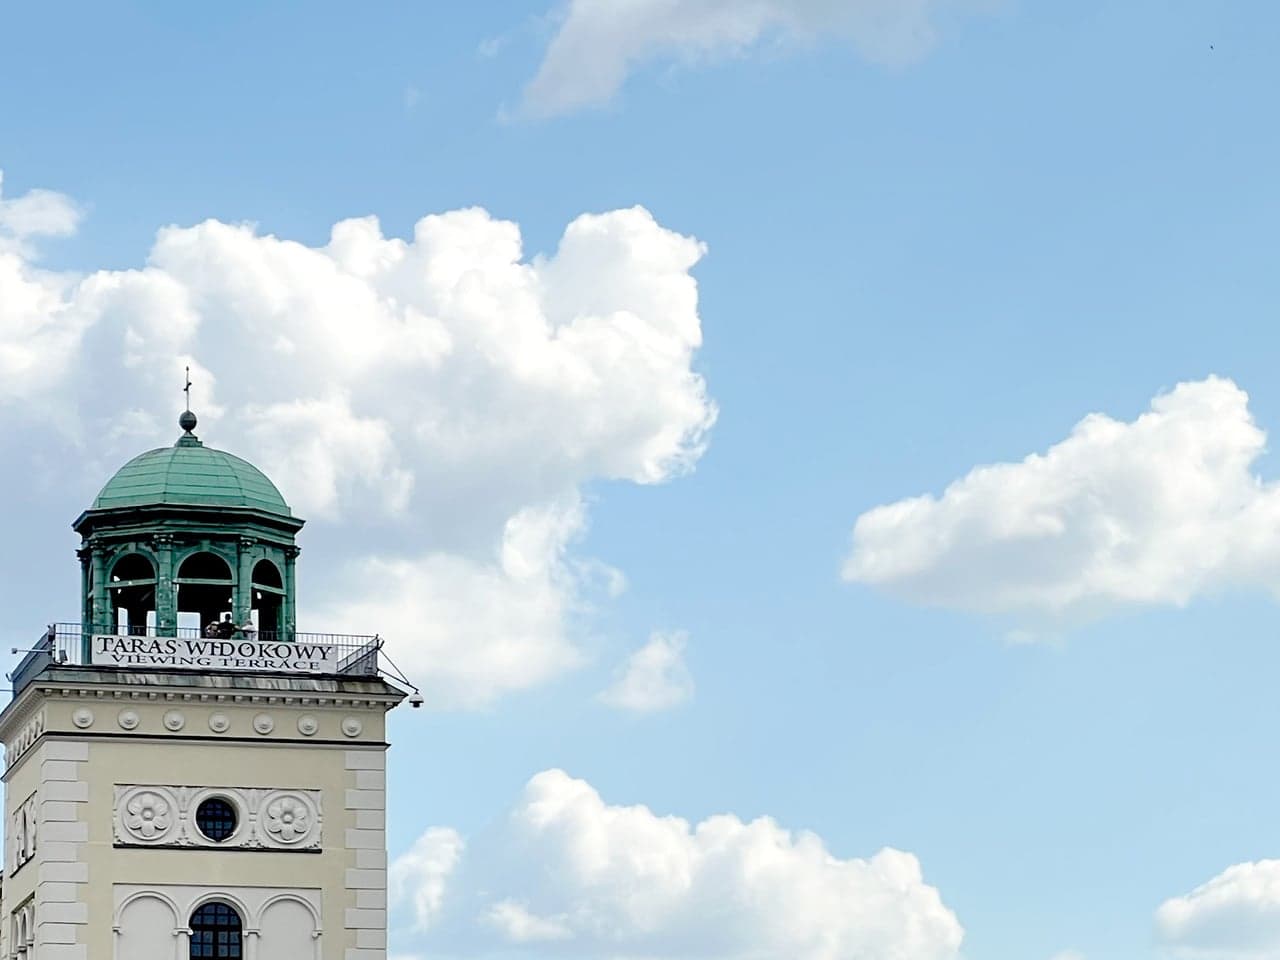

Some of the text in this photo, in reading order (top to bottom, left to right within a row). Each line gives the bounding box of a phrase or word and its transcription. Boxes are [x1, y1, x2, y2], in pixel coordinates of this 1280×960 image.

[97, 636, 333, 661] TARAS WIDOKOWY
[111, 654, 321, 671] VIEWING TERRACE
